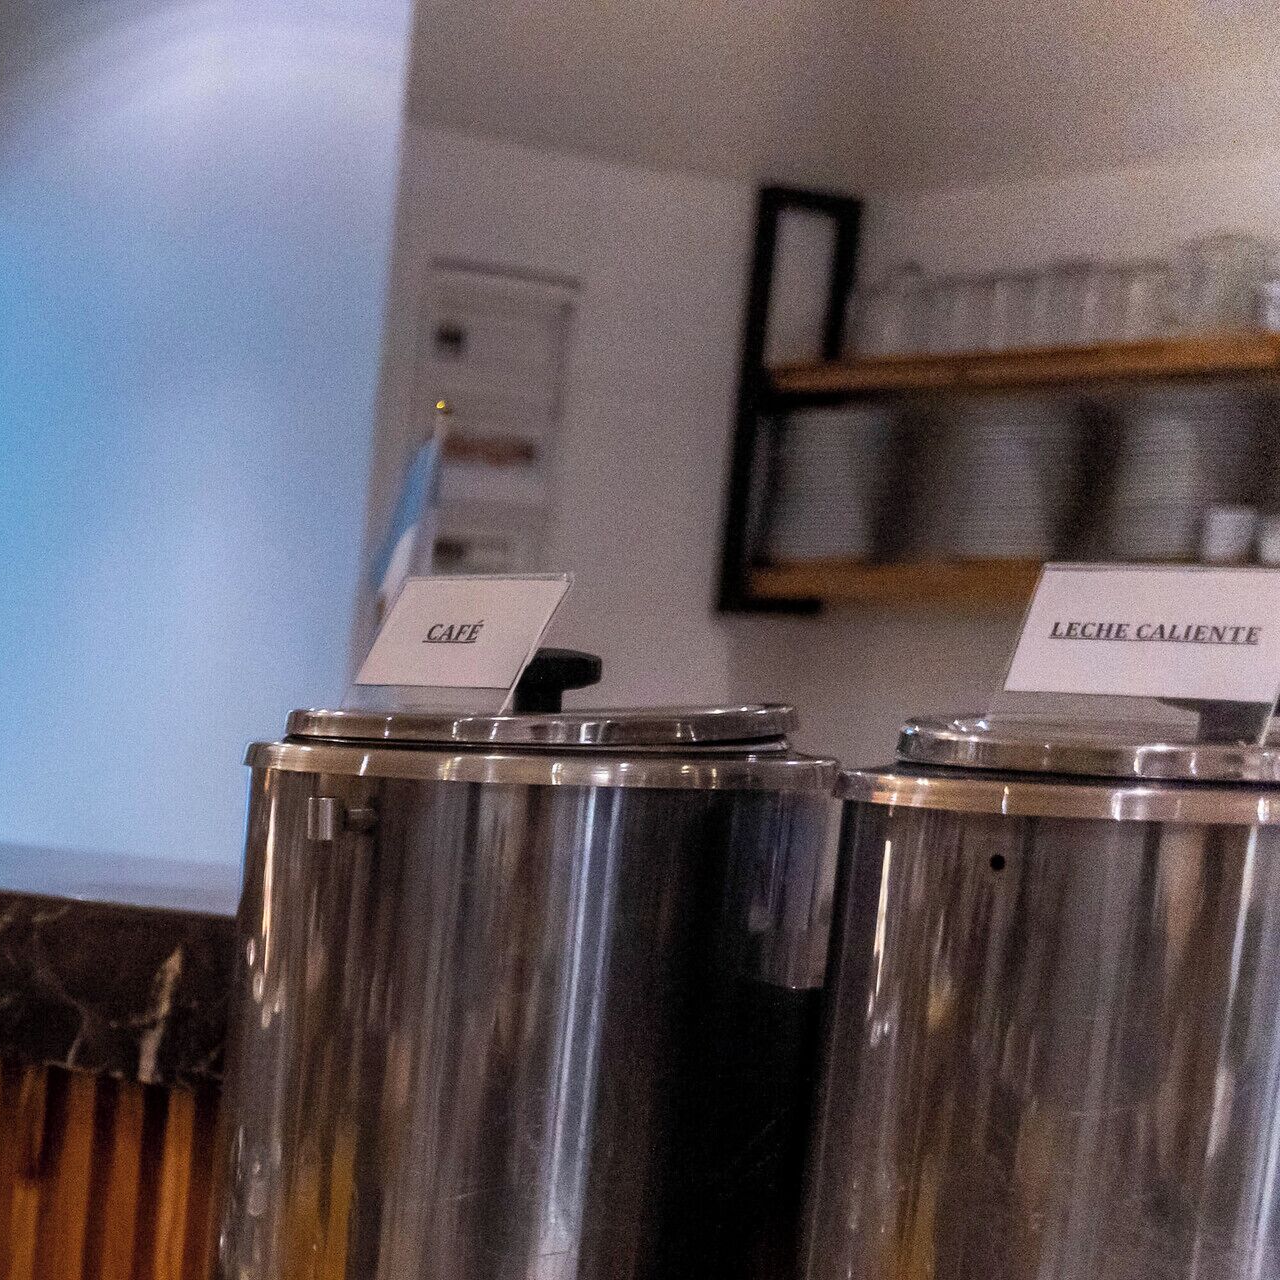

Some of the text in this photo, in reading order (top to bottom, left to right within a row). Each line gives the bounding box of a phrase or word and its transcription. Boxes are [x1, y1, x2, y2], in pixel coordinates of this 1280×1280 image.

[424, 620, 485, 642] CAFÉ
[1049, 621, 1262, 645] LECHE CALIENTE
